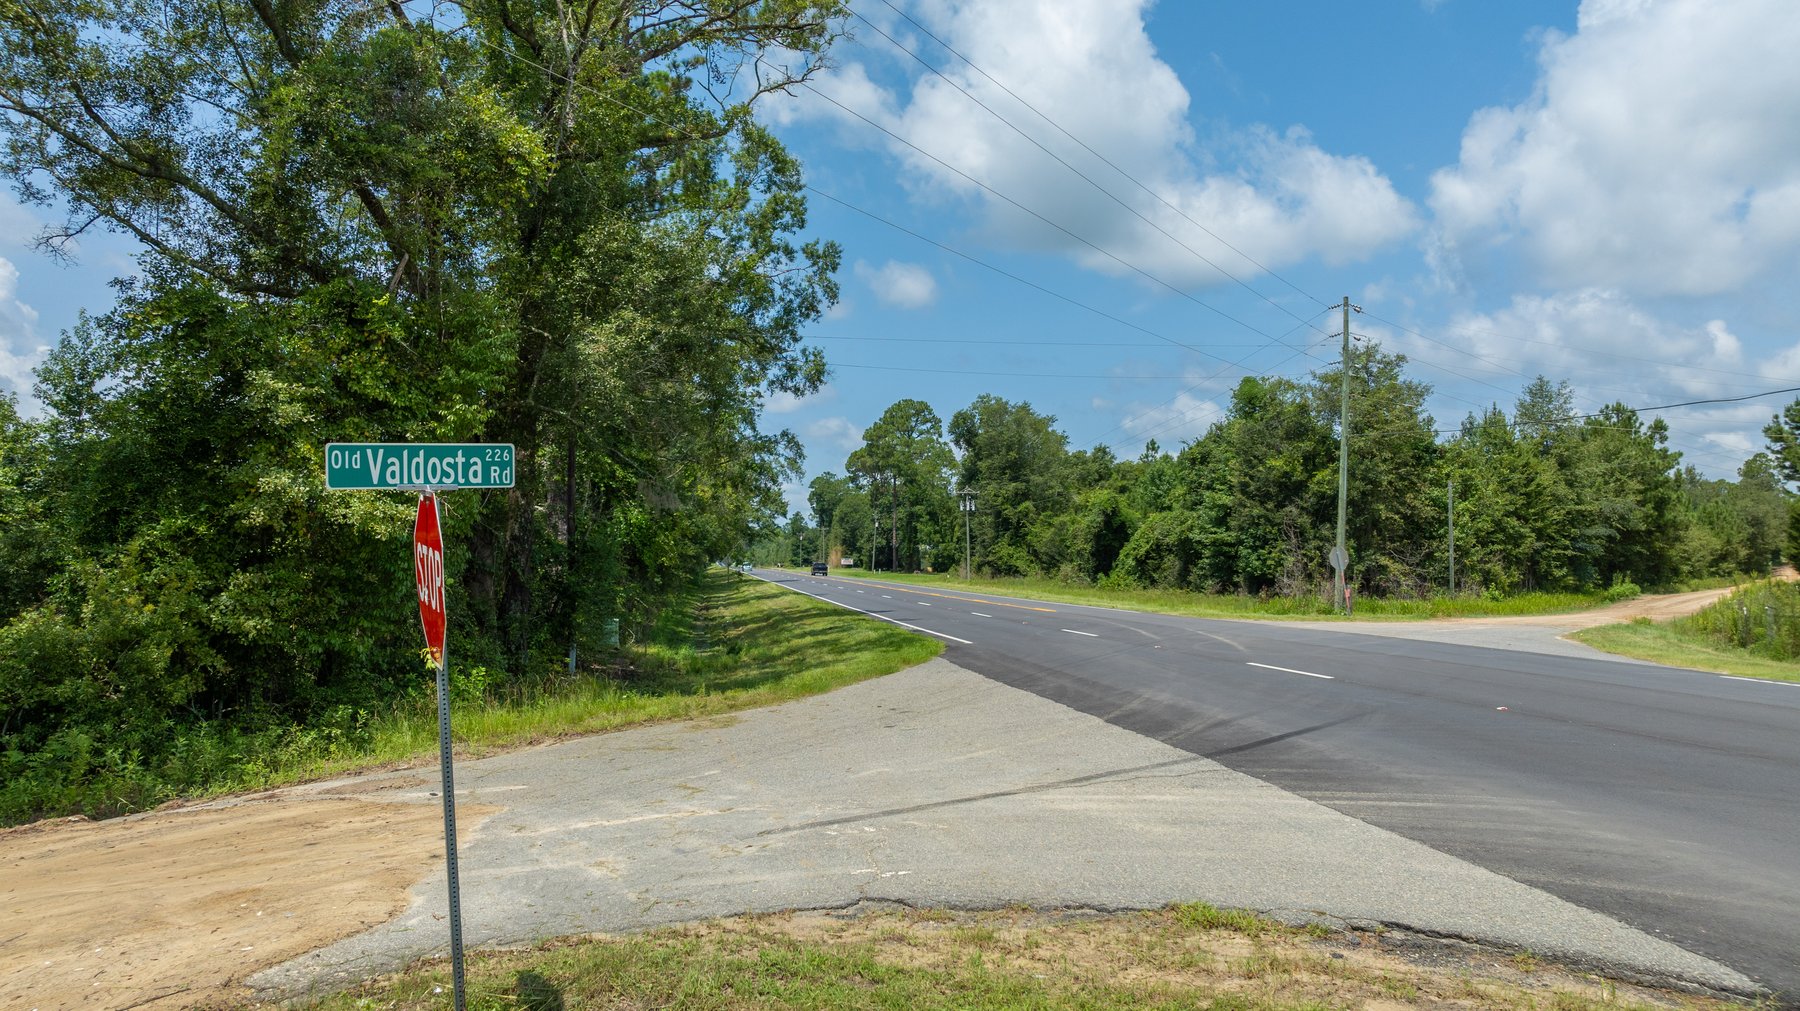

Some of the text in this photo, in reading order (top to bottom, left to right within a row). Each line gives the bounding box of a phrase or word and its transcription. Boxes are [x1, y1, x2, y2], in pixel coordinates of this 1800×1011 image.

[331, 449, 511, 485] Old Valdosta Rd
[485, 449, 510, 461] 226
[417, 542, 441, 612] STOP
